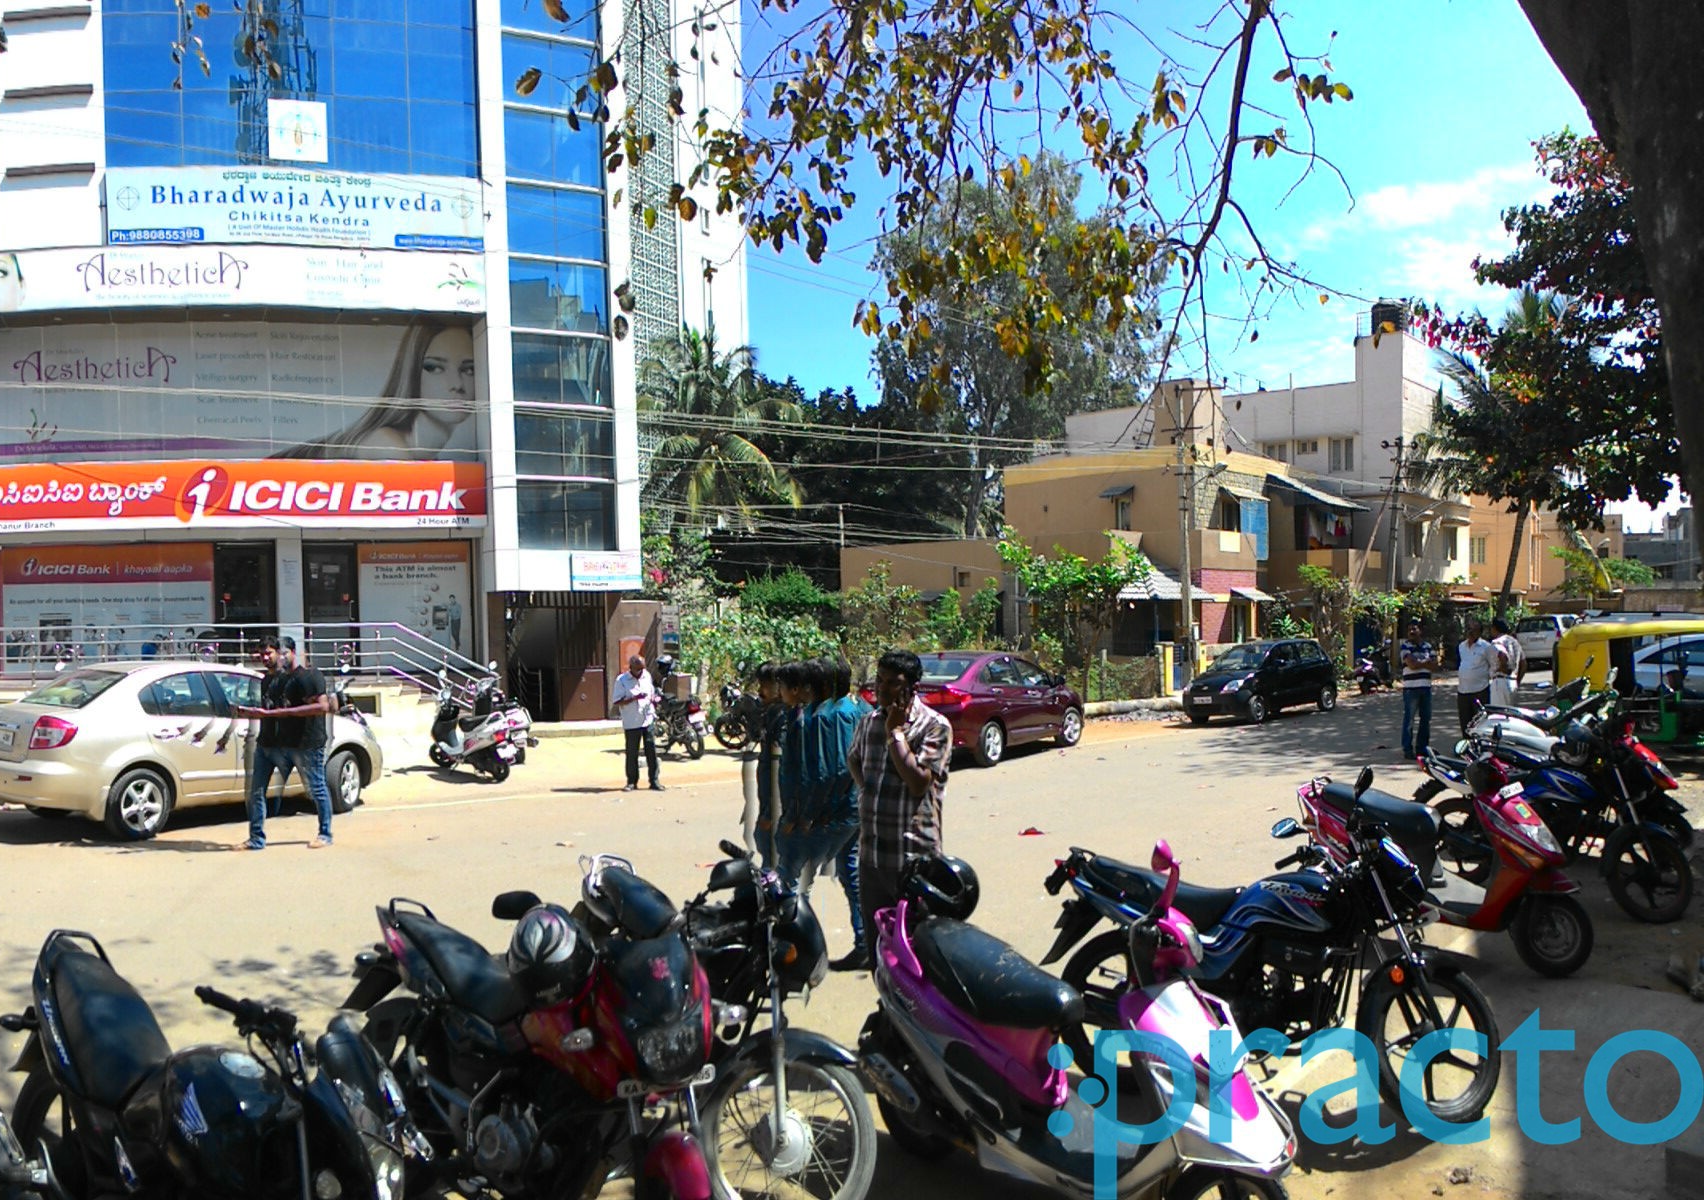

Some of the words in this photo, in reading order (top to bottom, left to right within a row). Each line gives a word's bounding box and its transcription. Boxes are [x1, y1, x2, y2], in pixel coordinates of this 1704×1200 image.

[150, 185, 309, 210] Bharadwaja
[320, 189, 441, 213] Ayurveda
[228, 211, 303, 222] Chikitsa
[309, 214, 370, 226] Kendra
[88, 476, 168, 516] ಬ್ಯಾಂಕ್
[229, 479, 346, 513] ICICI
[349, 480, 469, 512] Bank
[24, 521, 56, 530] Branch
[416, 517, 427, 526] 24
[428, 518, 449, 526] Hour
[450, 516, 470, 525] ATM
[38, 564, 75, 576] ICICI
[77, 563, 111, 575] Bank
